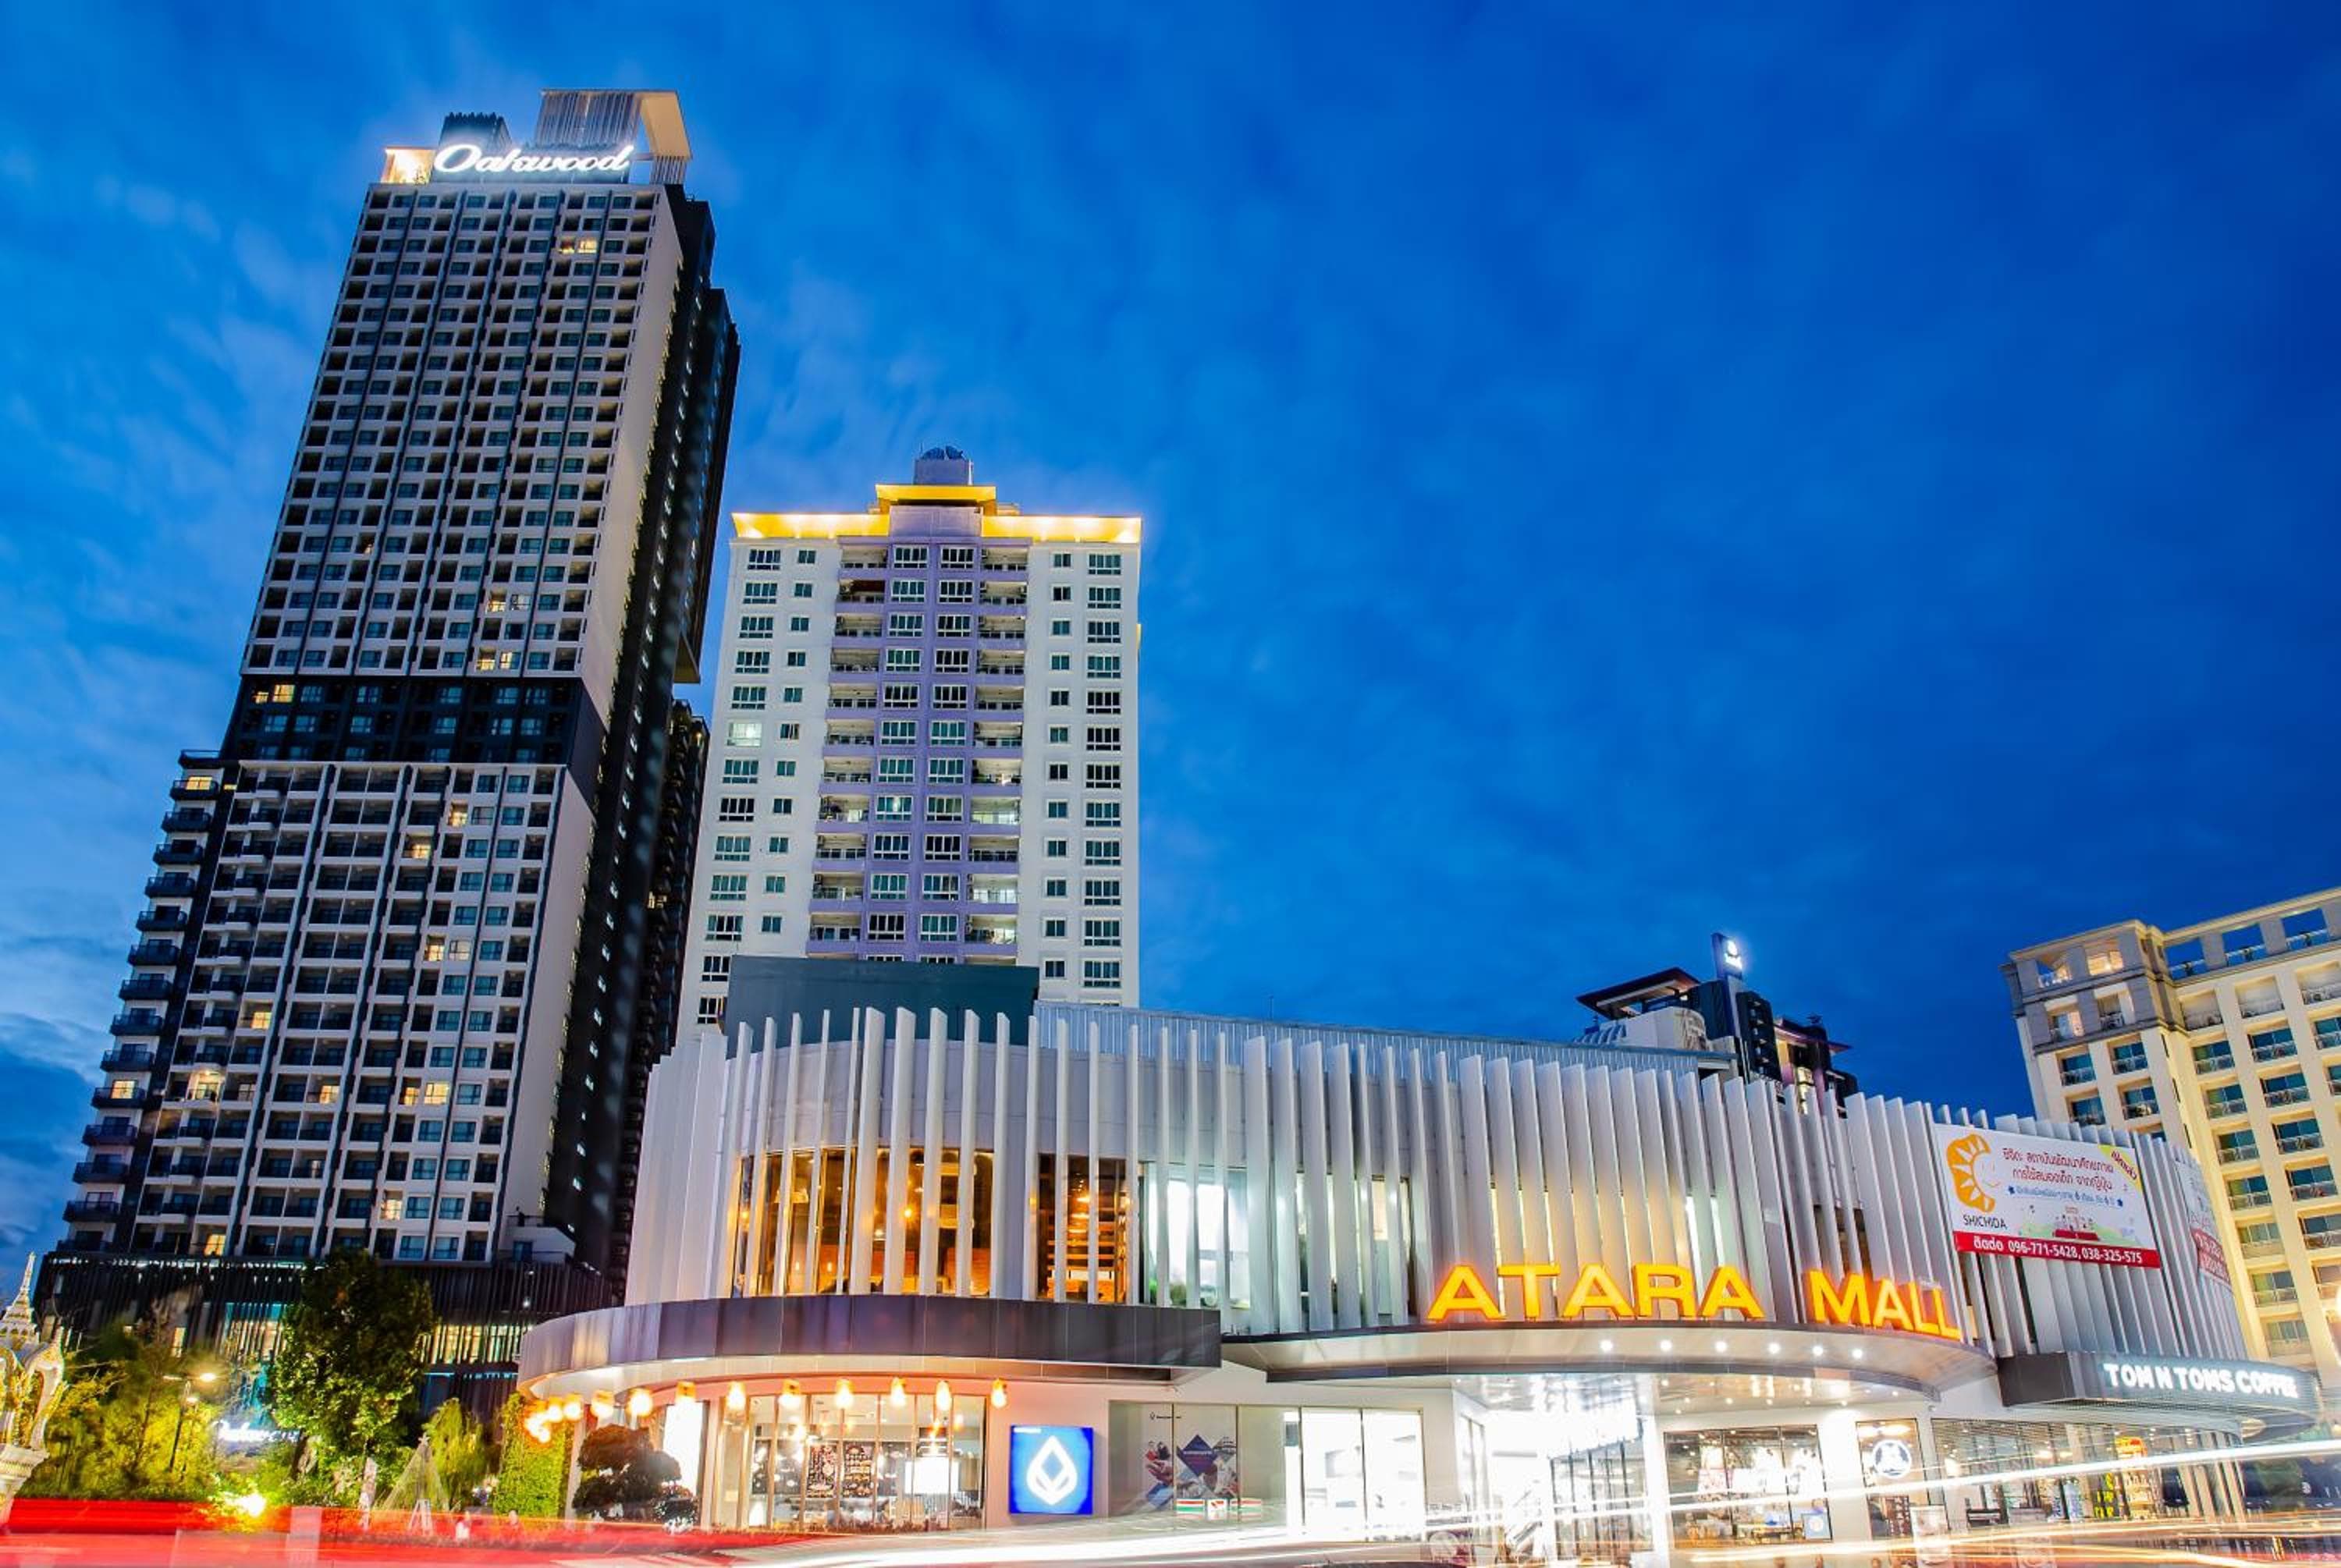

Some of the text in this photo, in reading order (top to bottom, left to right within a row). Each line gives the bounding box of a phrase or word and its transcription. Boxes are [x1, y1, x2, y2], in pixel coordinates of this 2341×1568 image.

[433, 144, 634, 174] Oakwood
[1963, 1214, 2008, 1230] SHICHIDA
[1426, 1263, 1963, 1341] ATARA MALL
[2103, 1364, 2155, 1388] TOM
[2155, 1365, 2173, 1390] N
[2173, 1368, 2236, 1393] TOMS
